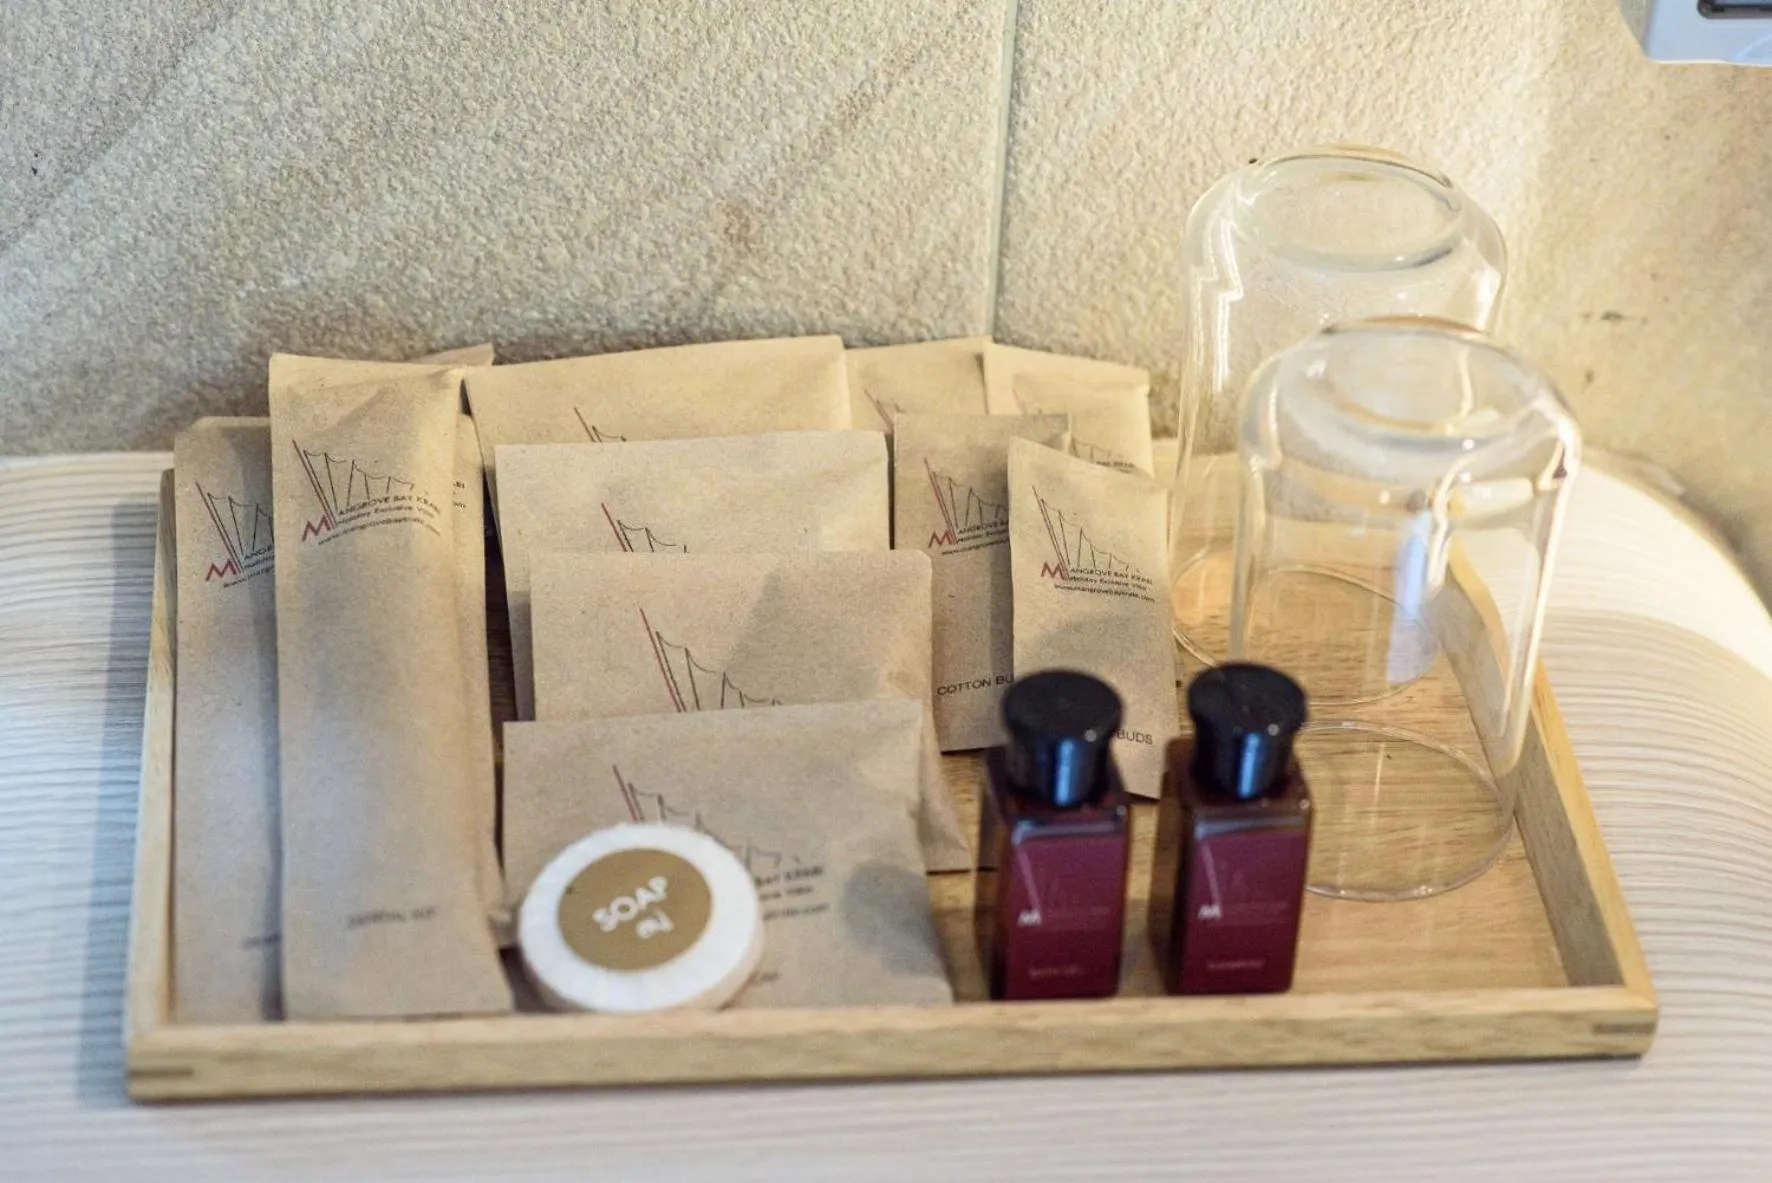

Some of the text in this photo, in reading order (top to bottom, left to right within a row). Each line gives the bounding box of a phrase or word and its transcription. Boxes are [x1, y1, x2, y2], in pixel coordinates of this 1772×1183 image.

[936, 677, 992, 697] COTTON
[1116, 728, 1154, 746] BUDS
[592, 875, 669, 933] SOAP
